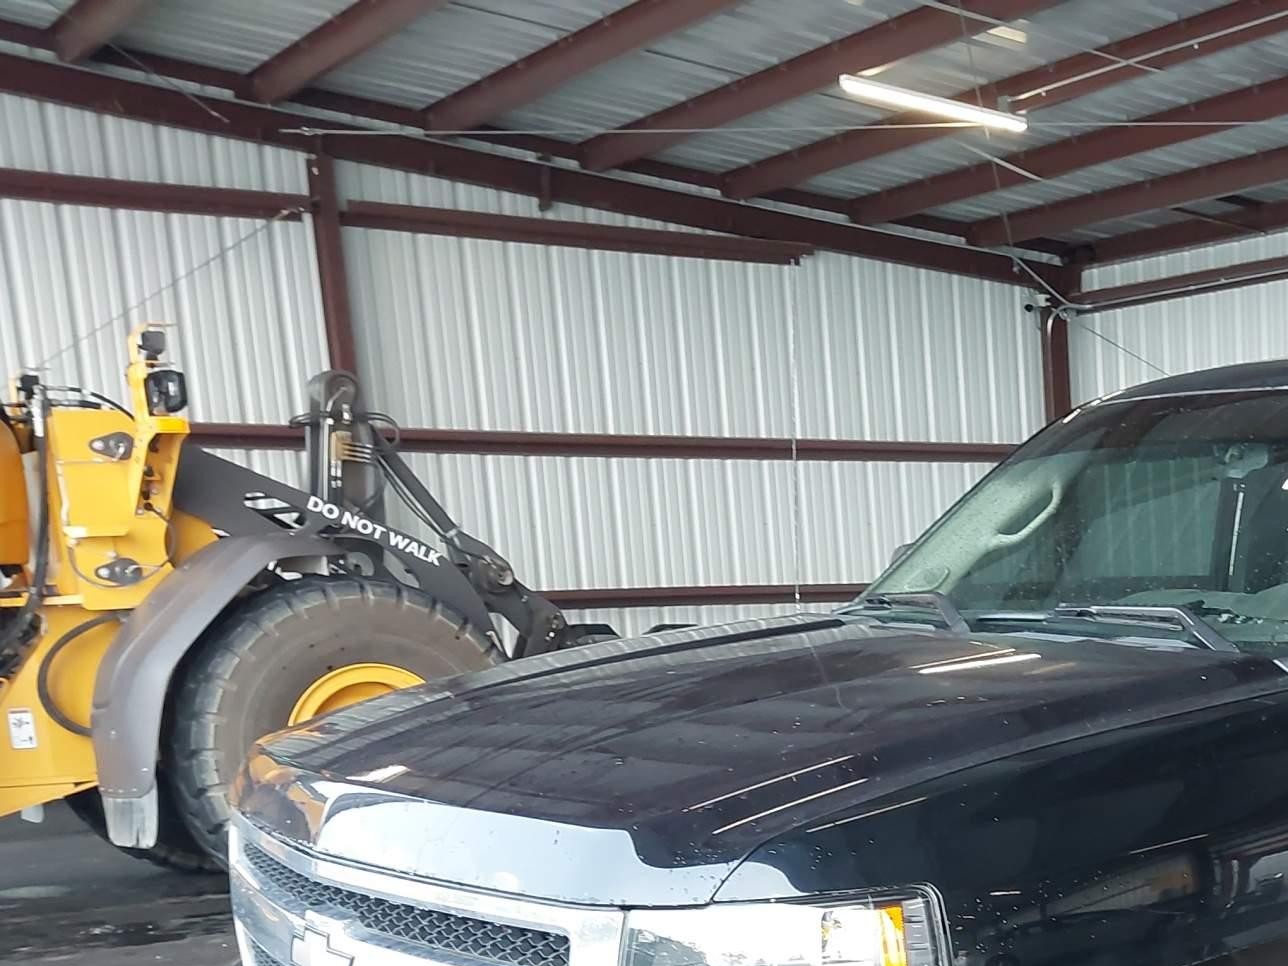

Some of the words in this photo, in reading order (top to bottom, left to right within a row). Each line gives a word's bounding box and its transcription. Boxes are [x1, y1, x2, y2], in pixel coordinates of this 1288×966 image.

[306, 495, 340, 519] DO
[341, 511, 387, 540] NOT
[388, 531, 444, 566] WALK
